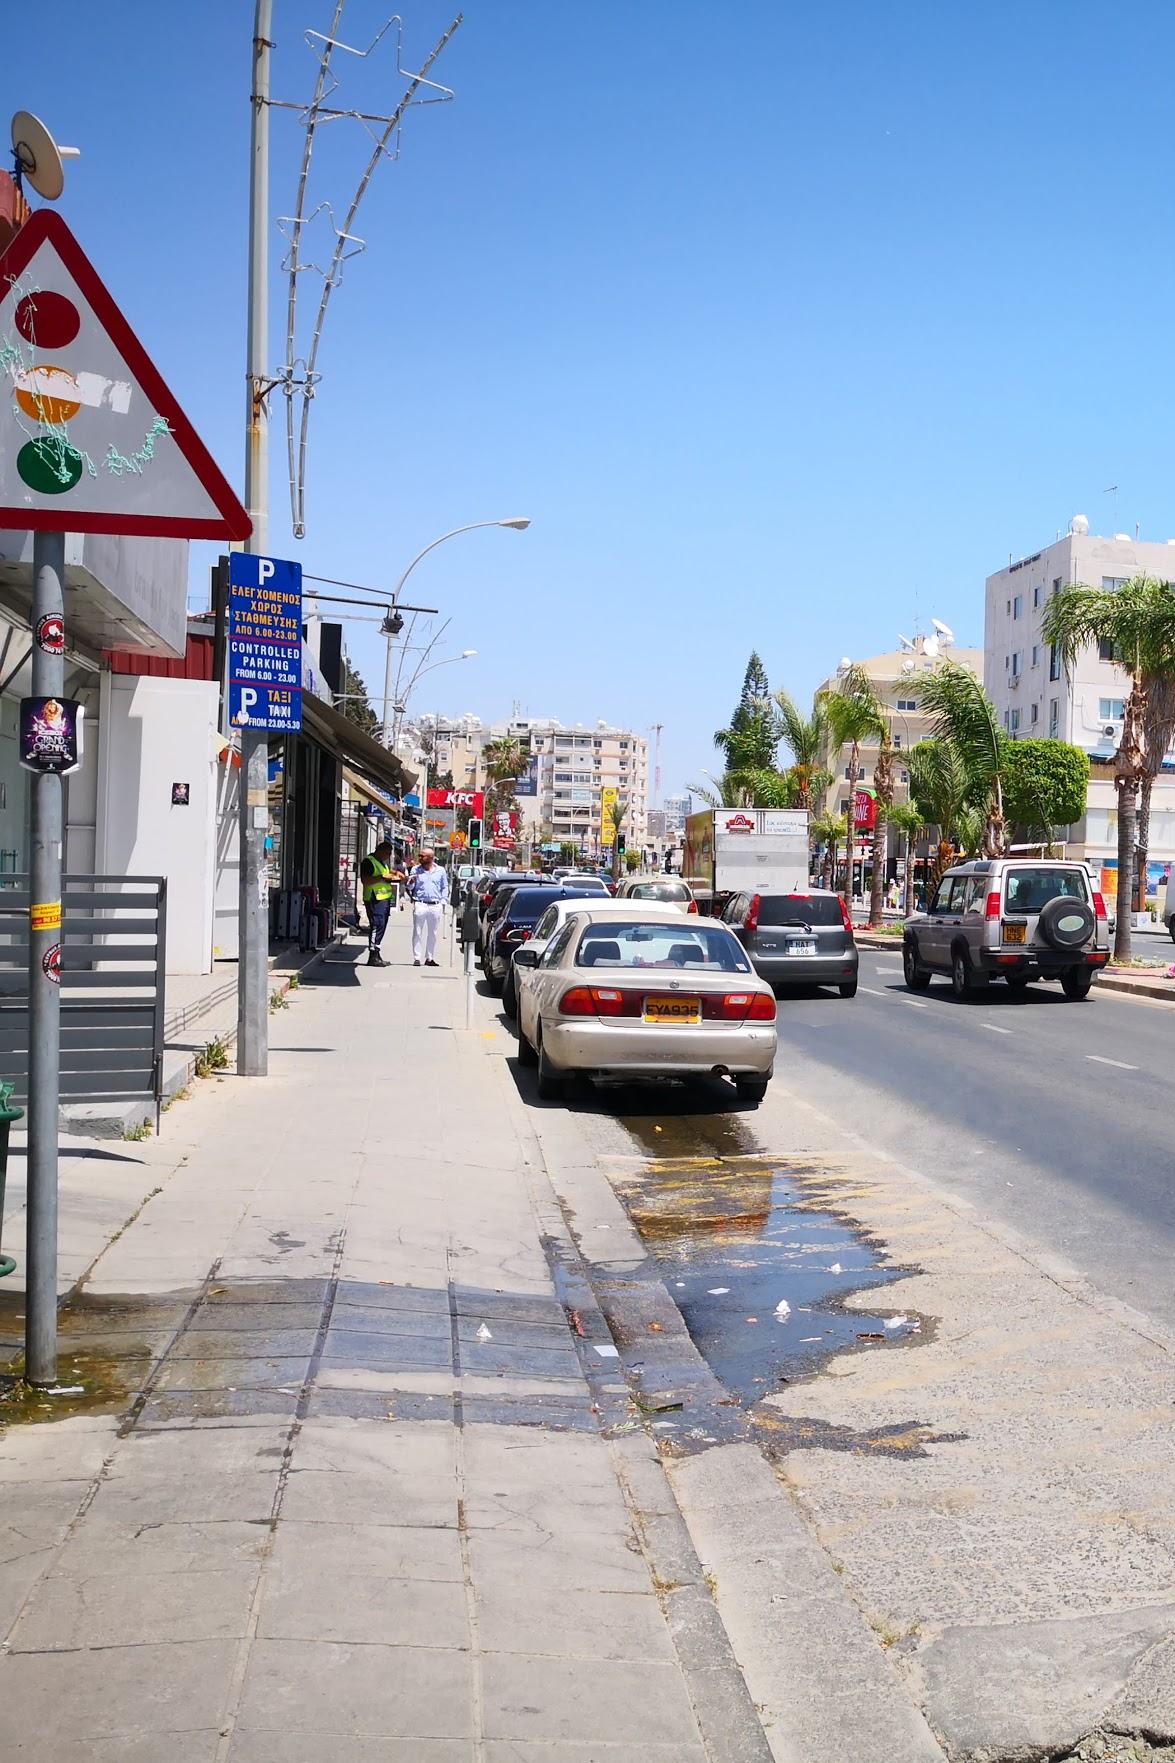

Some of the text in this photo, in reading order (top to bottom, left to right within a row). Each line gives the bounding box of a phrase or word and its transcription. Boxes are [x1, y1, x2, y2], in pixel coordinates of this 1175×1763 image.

[259, 559, 275, 585] P
[232, 585, 300, 605] ΕΛΕΓΧΟΜΕΝΟΣ
[251, 601, 282, 614] ΧΩΡΟΣ
[235, 611, 297, 629] ΣΤΑΘΜΕΥΣΗΣ
[236, 625, 297, 640] ΑΠΟ 6.00-23.00
[232, 642, 300, 659] CONTROLLED
[243, 656, 289, 671] PARKING
[236, 668, 255, 679] FROM
[257, 671, 272, 680] 6.00
[278, 673, 296, 683] 23.00
[241, 687, 257, 714] P
[267, 690, 291, 703] ΤΑΞΙ
[268, 705, 291, 718] TAXI
[249, 717, 267, 727] FROM
[35, 735, 64, 744] GRAND
[445, 791, 475, 805] KFC
